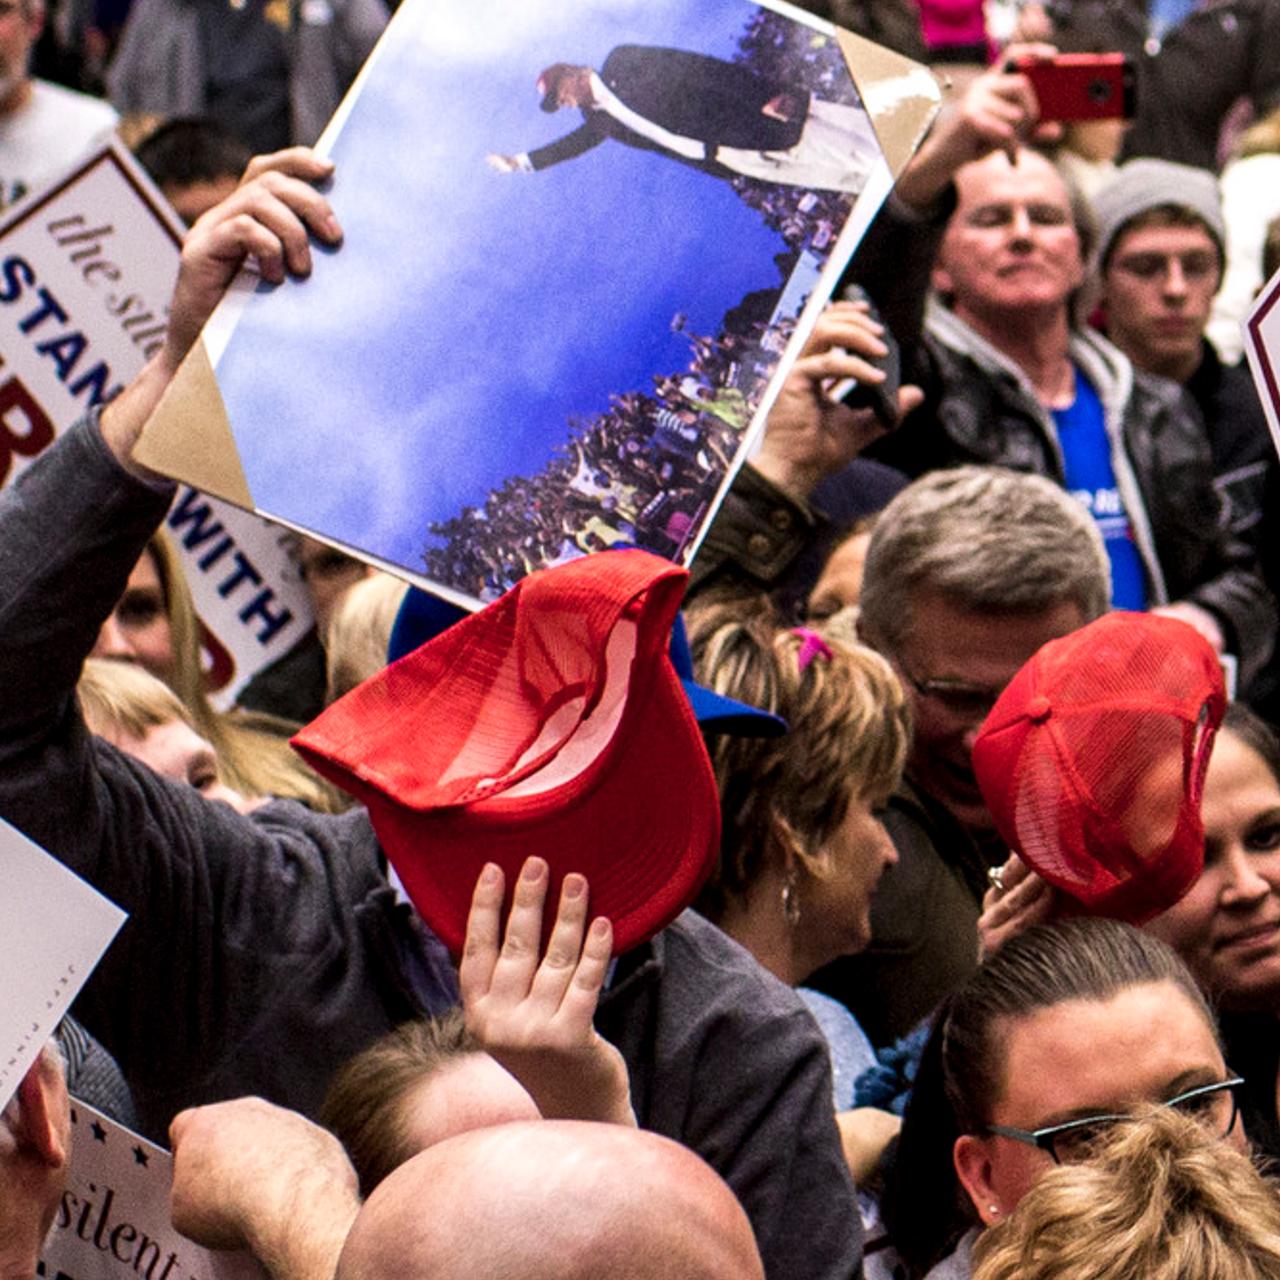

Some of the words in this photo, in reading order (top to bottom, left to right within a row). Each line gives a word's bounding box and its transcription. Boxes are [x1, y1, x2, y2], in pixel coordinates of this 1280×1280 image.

[48, 215, 121, 287] the
[105, 292, 170, 362] sile
[0, 253, 124, 411] STAN
[168, 488, 294, 647] WITH
